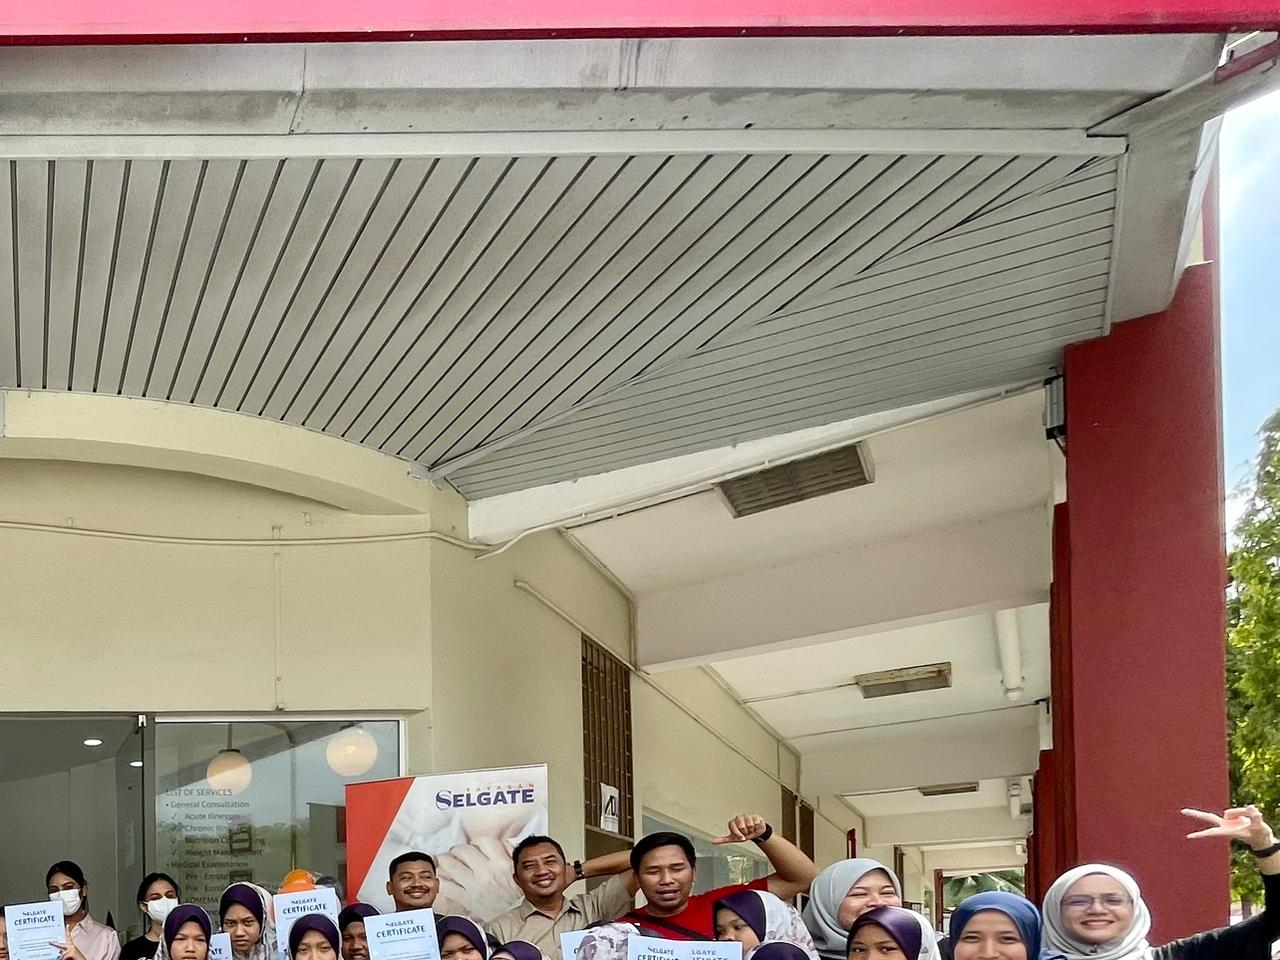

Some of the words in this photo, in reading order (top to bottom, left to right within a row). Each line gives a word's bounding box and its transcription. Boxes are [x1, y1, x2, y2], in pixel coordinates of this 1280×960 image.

[435, 790, 535, 811] SELGATE
[283, 903, 327, 915] CERTIFICATE
[14, 915, 55, 925] CERTIFICATE
[376, 926, 425, 938] CERTIFICATE
